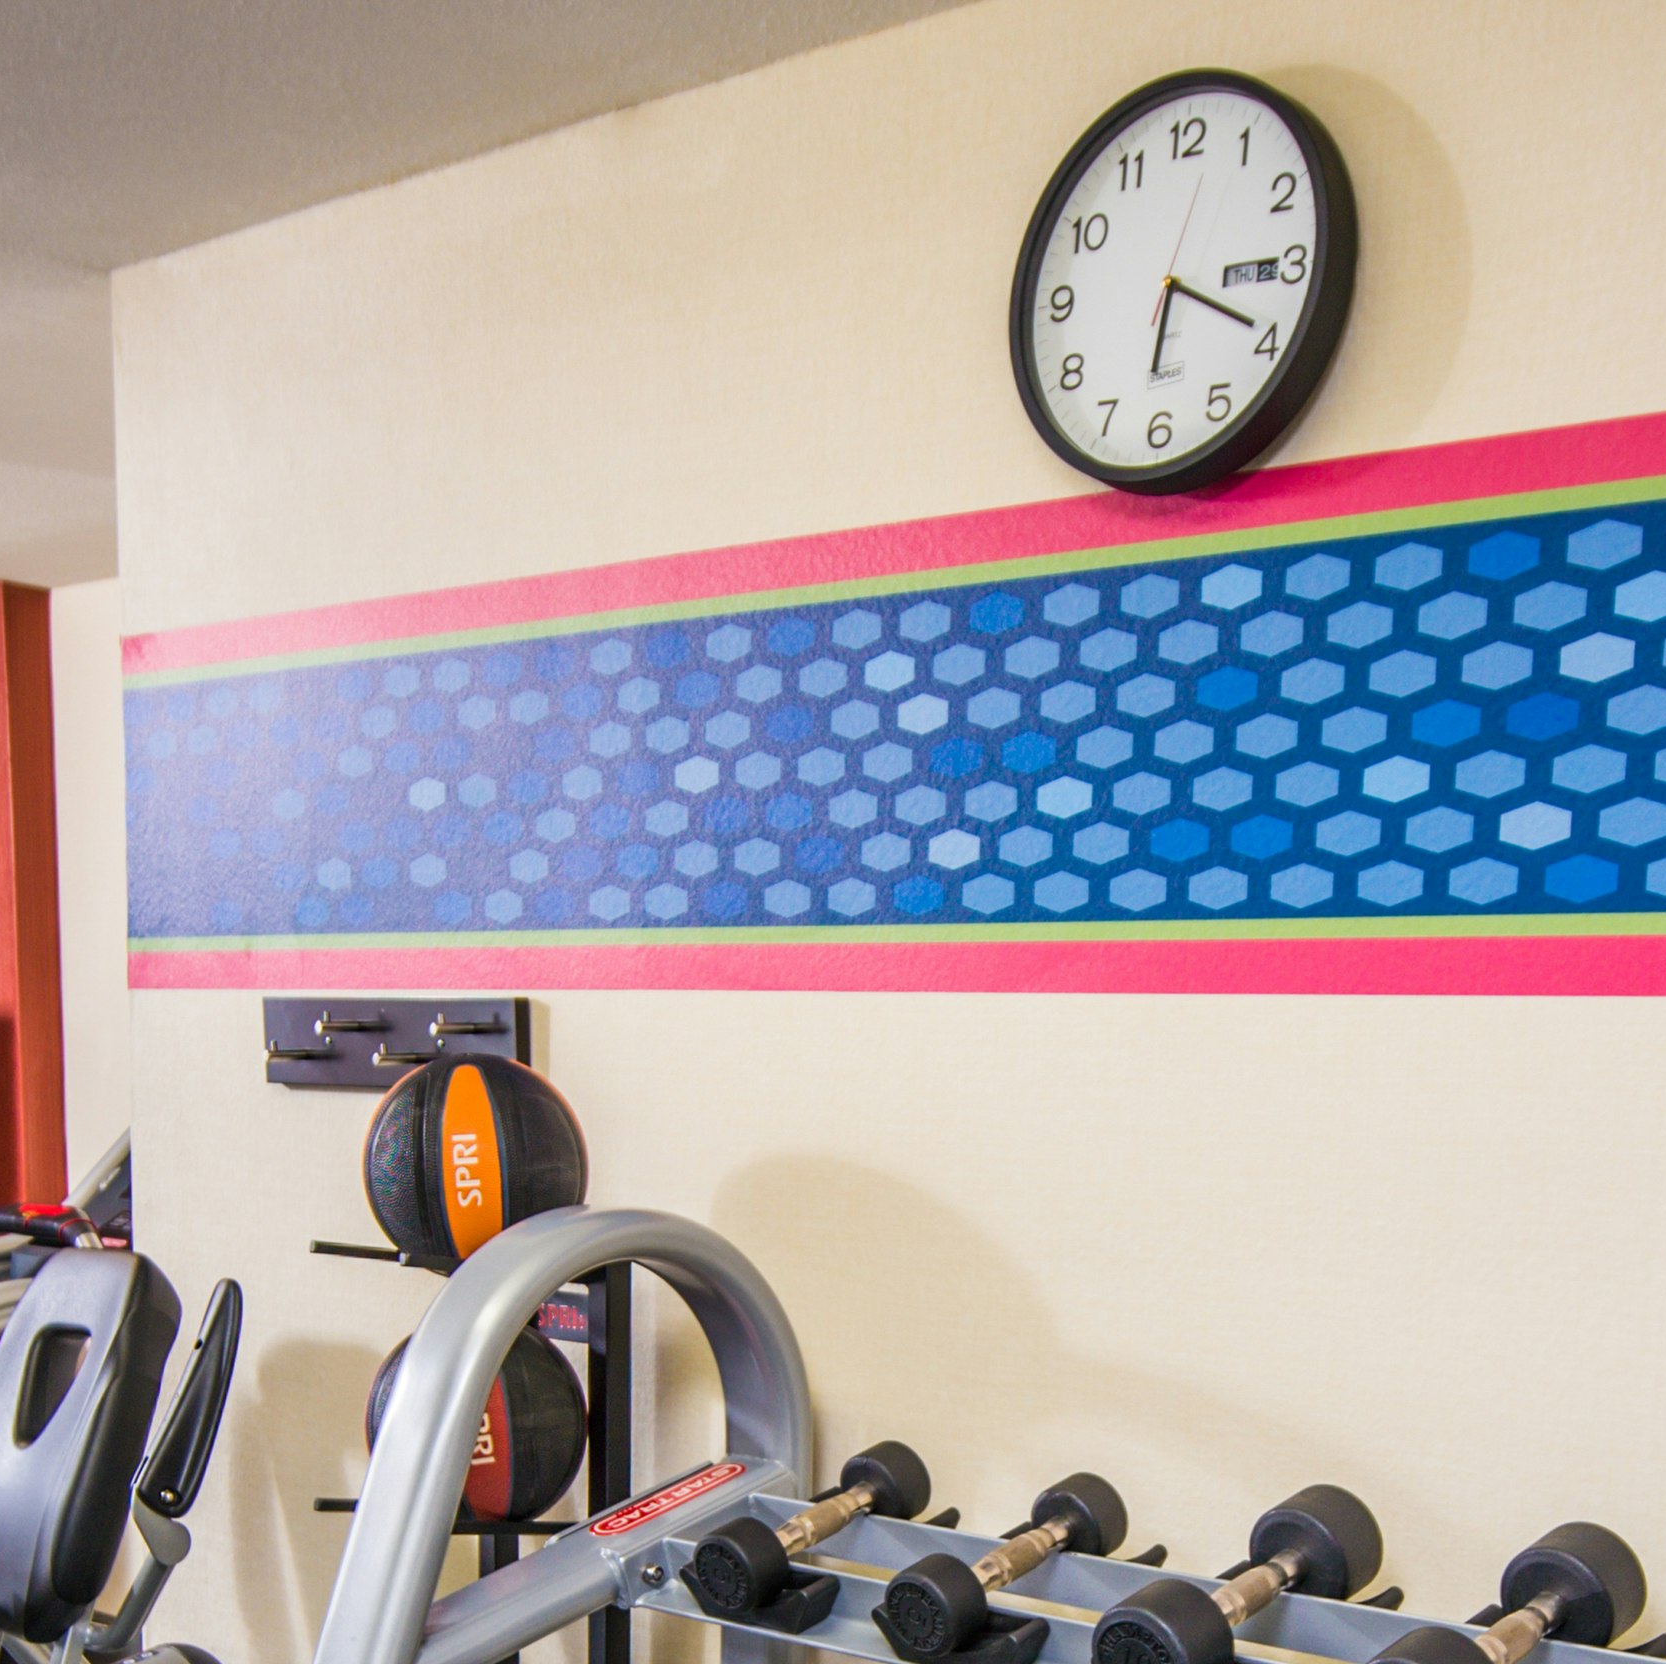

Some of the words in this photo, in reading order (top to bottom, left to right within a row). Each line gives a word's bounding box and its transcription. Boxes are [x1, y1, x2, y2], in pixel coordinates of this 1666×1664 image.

[1170, 117, 1207, 160] 12
[1239, 126, 1250, 166] 1
[1118, 150, 1144, 191] 11
[1270, 172, 1296, 213] 2
[1072, 213, 1109, 253] 10
[1233, 267, 1255, 284] THU
[1280, 244, 1307, 284] 3
[1050, 285, 1074, 322] 9
[1254, 323, 1280, 361] 4
[1060, 353, 1084, 390] 8
[1150, 367, 1182, 383] STAPLES
[1097, 398, 1119, 436] 7
[1205, 383, 1231, 421] 5
[1147, 411, 1172, 448] 6
[452, 1133, 482, 1207] SPRI
[538, 1303, 577, 1329] SPRI
[672, 1469, 730, 1497] STAR
[608, 1495, 675, 1528] TRAC
